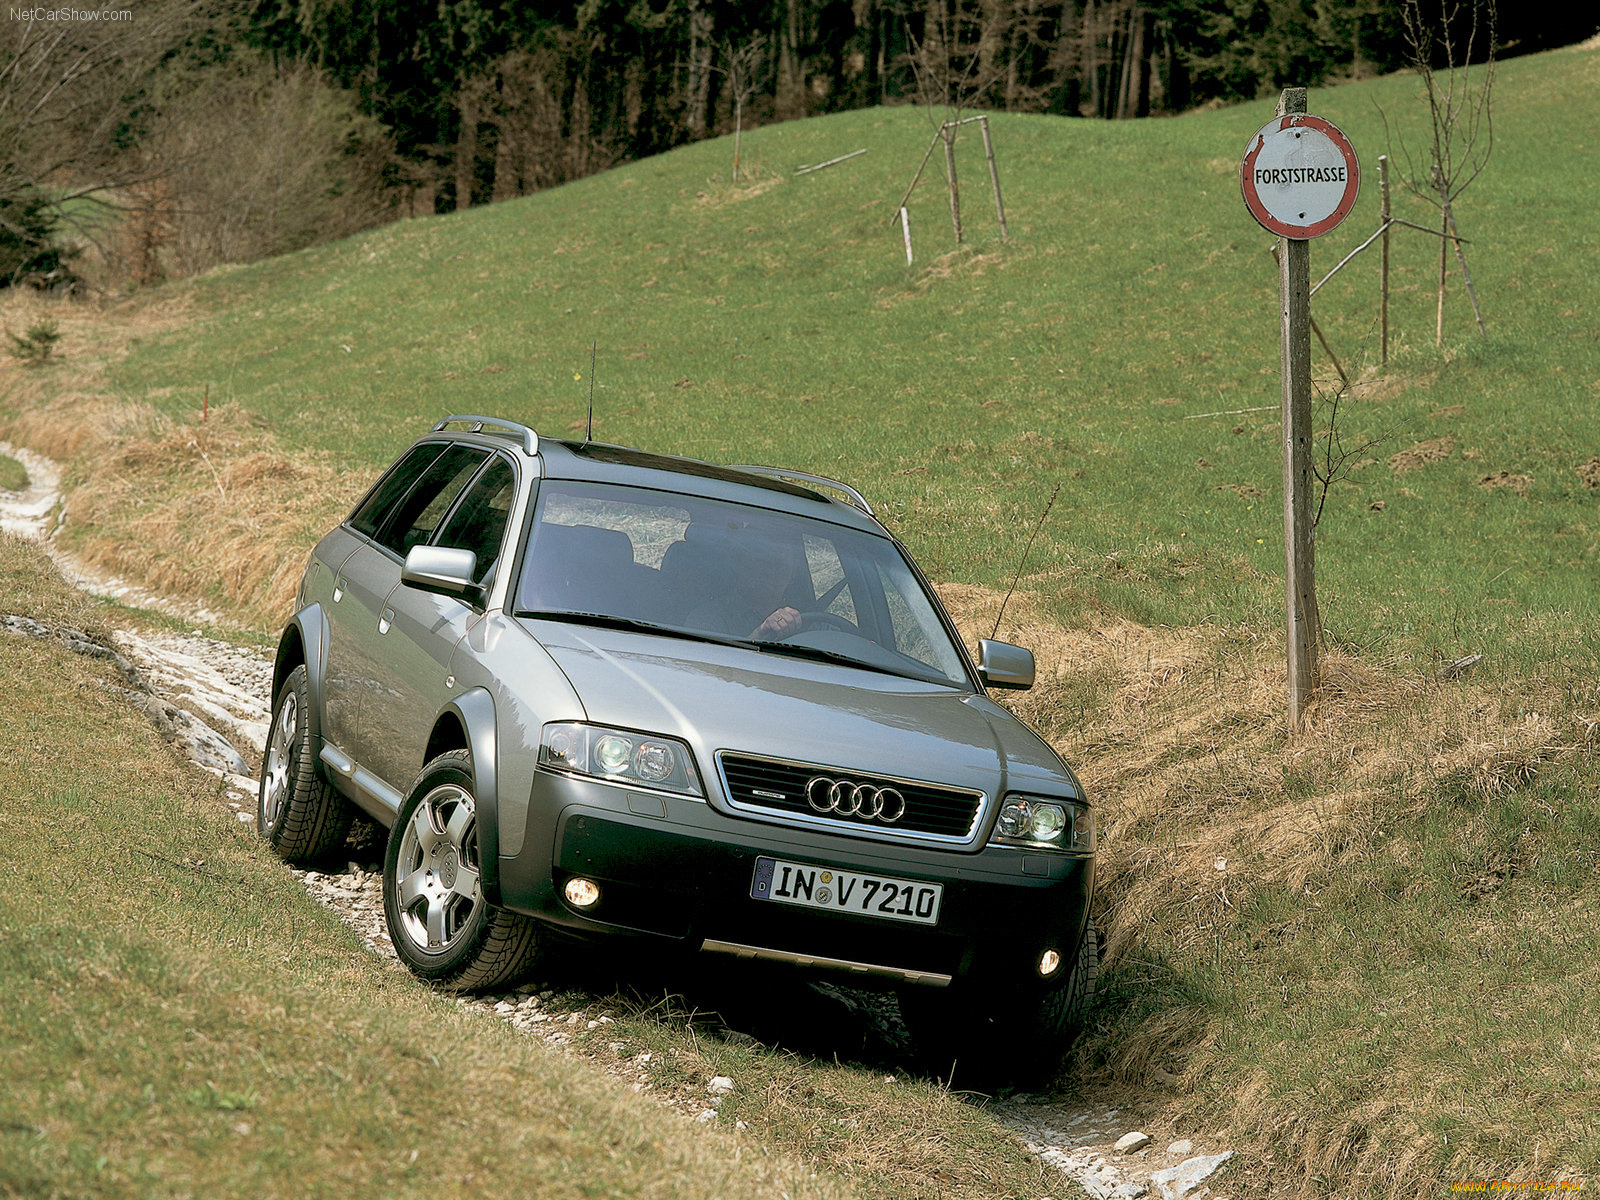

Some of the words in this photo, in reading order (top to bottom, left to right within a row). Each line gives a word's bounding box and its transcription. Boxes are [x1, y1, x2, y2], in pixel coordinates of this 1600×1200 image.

[1255, 167, 1345, 184] FORSTSTRASSE
[758, 881, 766, 891] D
[775, 867, 816, 901] IN
[838, 875, 857, 906] V
[862, 879, 935, 918] 7210
